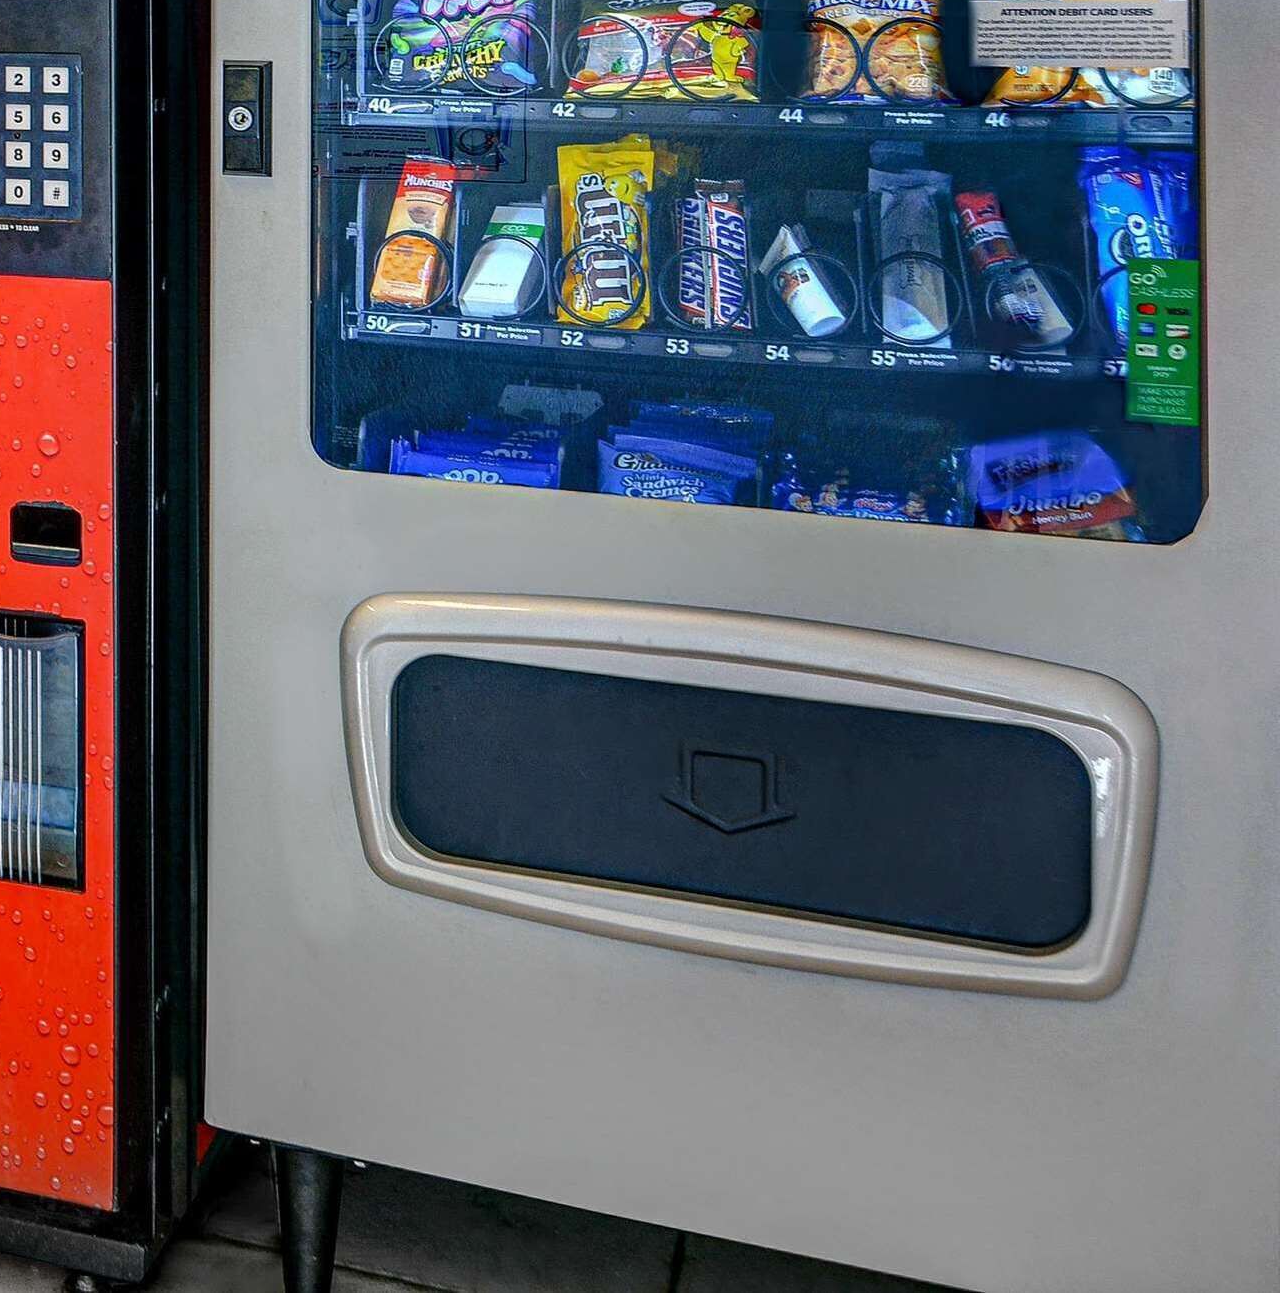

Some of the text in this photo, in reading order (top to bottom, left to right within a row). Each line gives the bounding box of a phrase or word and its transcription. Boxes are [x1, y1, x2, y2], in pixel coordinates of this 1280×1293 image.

[13, 73, 23, 86] 2
[51, 74, 61, 87] 3
[368, 98, 391, 112] 40
[551, 103, 576, 118] 42
[14, 111, 23, 123] 5
[52, 111, 61, 124] 6
[779, 108, 804, 123] 44
[985, 112, 1012, 127] 46
[13, 148, 23, 161] 8
[52, 149, 61, 162] 9
[404, 173, 455, 192] MUNCHIES
[14, 186, 24, 198] 0
[713, 209, 752, 329] SNICKERS
[1129, 271, 1157, 285] GO
[1129, 285, 1197, 300] CASHLESS
[366, 315, 389, 330] 50
[459, 323, 482, 338] 51
[560, 330, 584, 347] 52
[665, 338, 690, 354] 53
[765, 345, 791, 361] 54
[870, 350, 897, 366] 55
[621, 473, 705, 490] Sandwich
[1009, 491, 1102, 515] Jumbo
